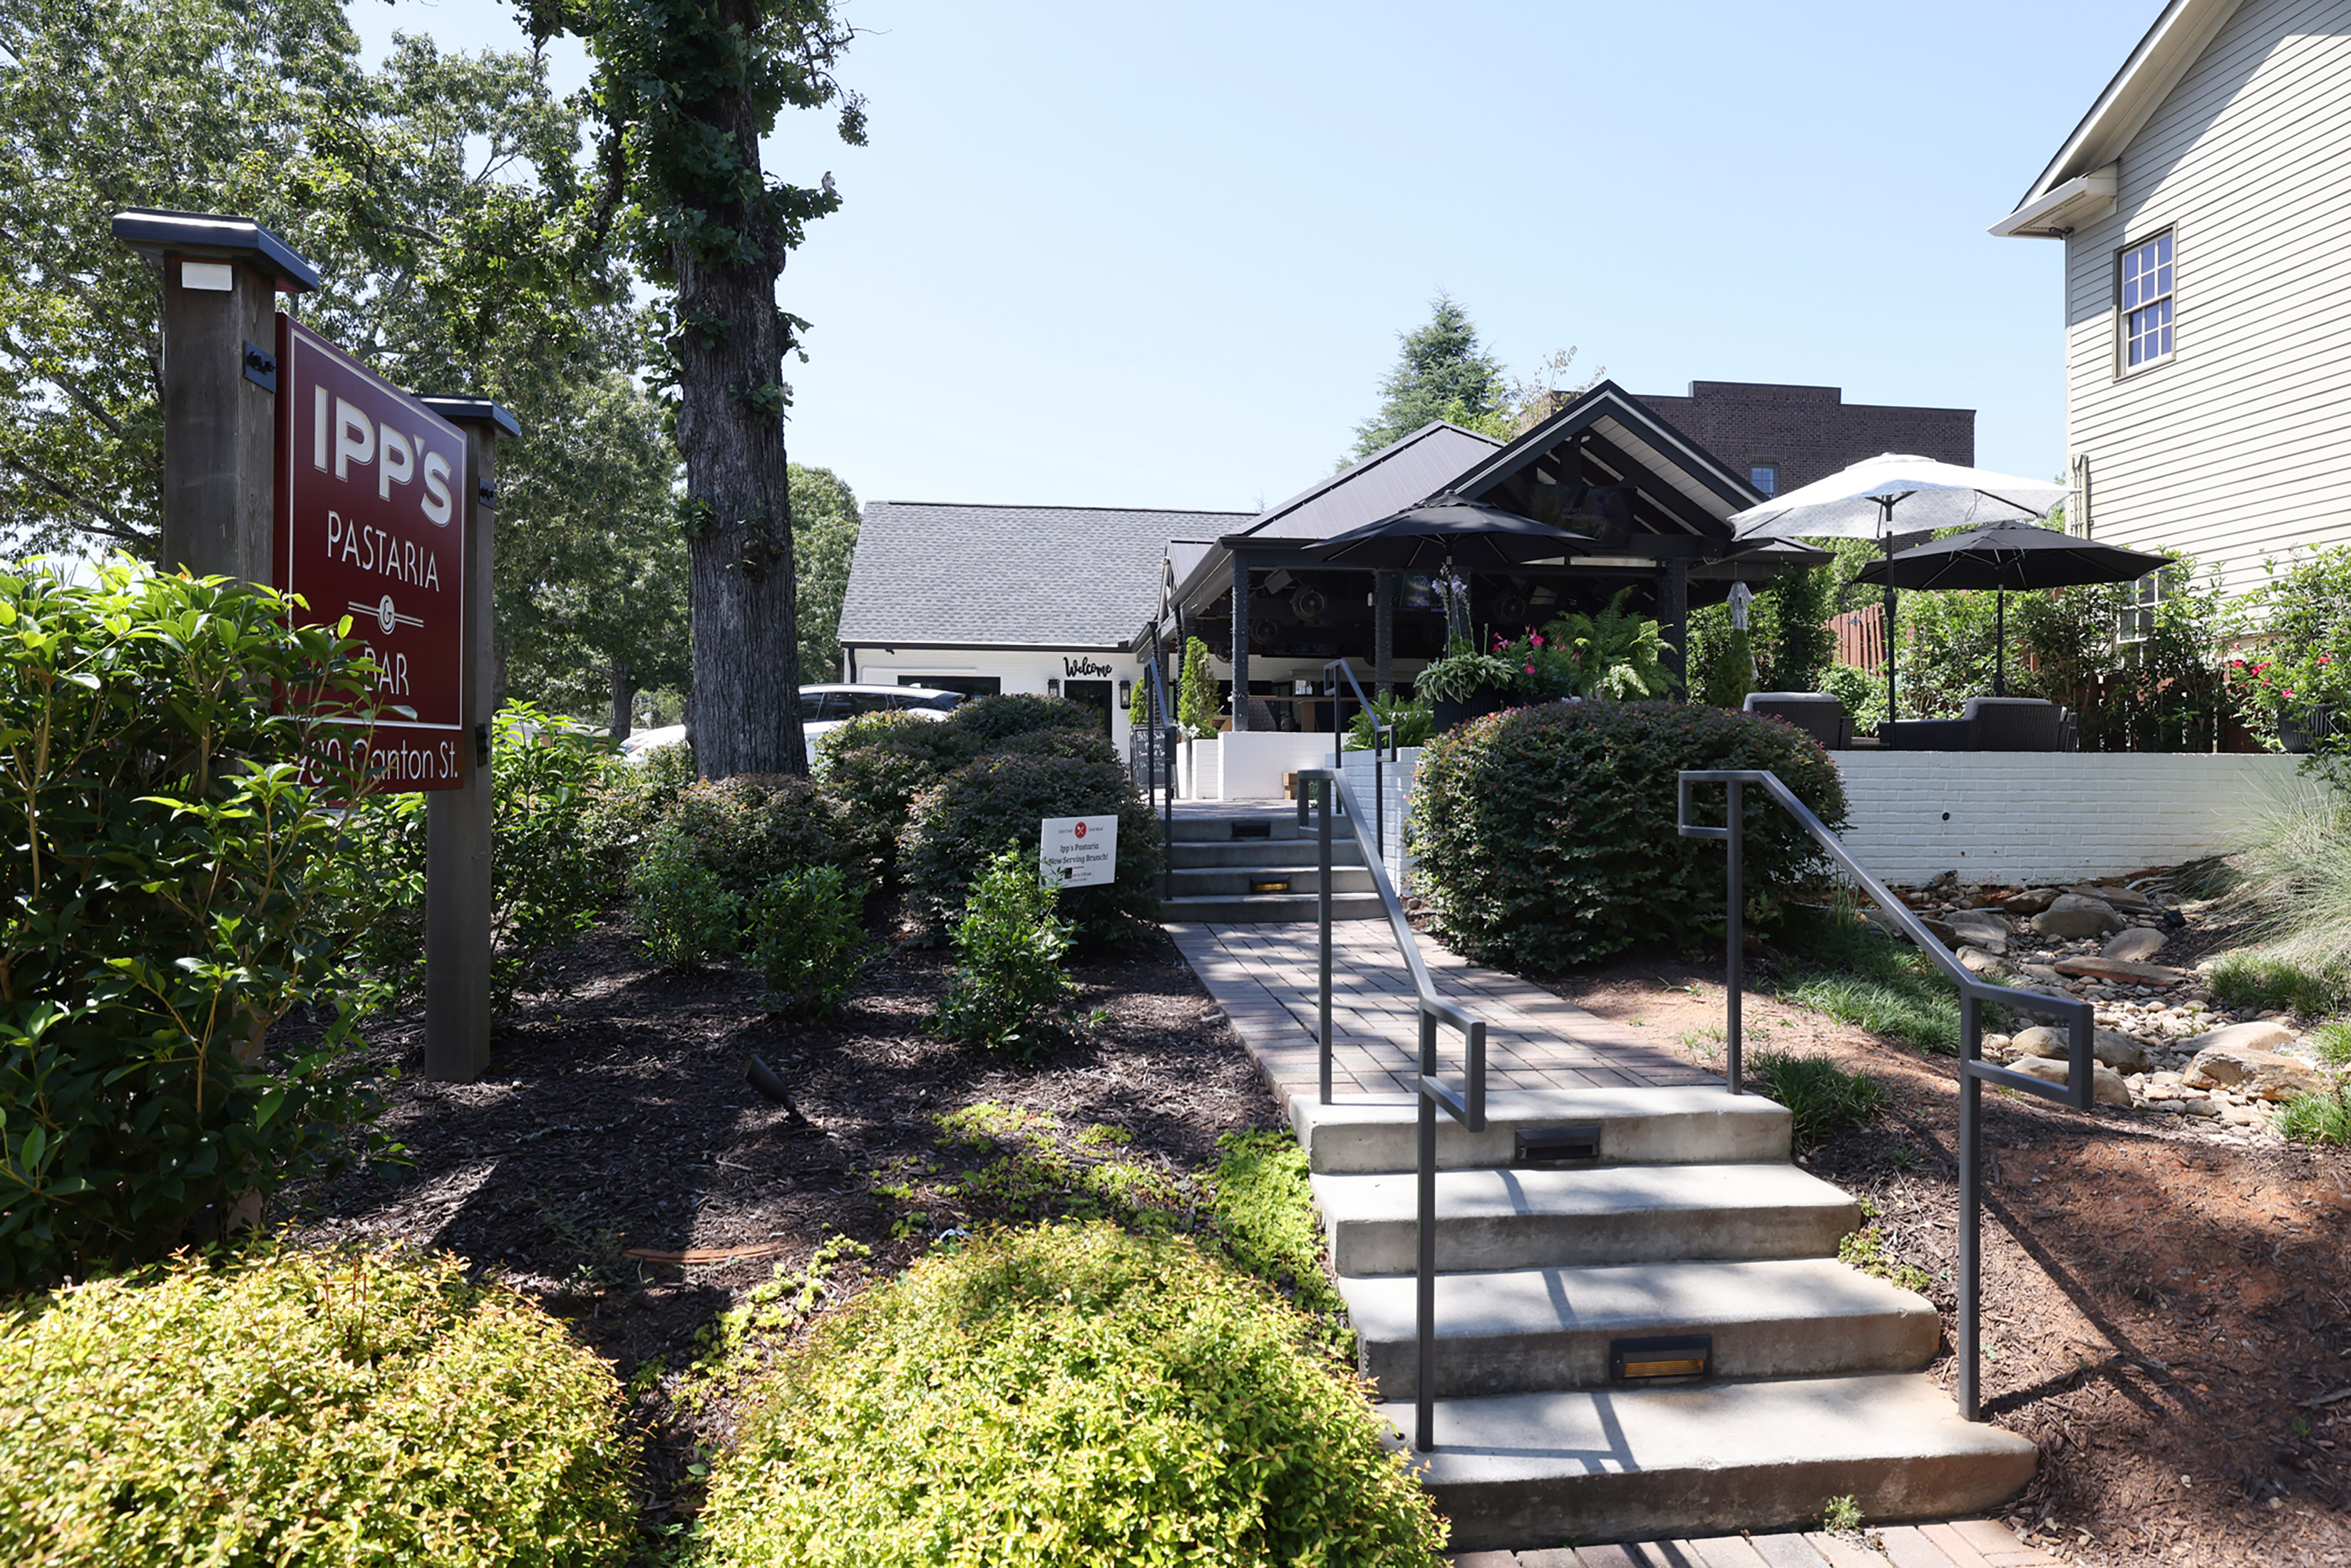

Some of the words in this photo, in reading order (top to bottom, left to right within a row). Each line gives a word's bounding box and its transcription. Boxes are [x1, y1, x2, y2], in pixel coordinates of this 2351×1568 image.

[314, 384, 453, 528] IPP'S
[327, 510, 440, 592] PASTARIA
[364, 646, 409, 696] BAR
[1063, 656, 1112, 677] Welcome
[439, 741, 458, 779] St.
[1060, 845, 1074, 854] Ipp's
[1075, 842, 1099, 851] Pastaria
[1063, 855, 1085, 864] Serving
[1086, 852, 1108, 862] Brunch!
